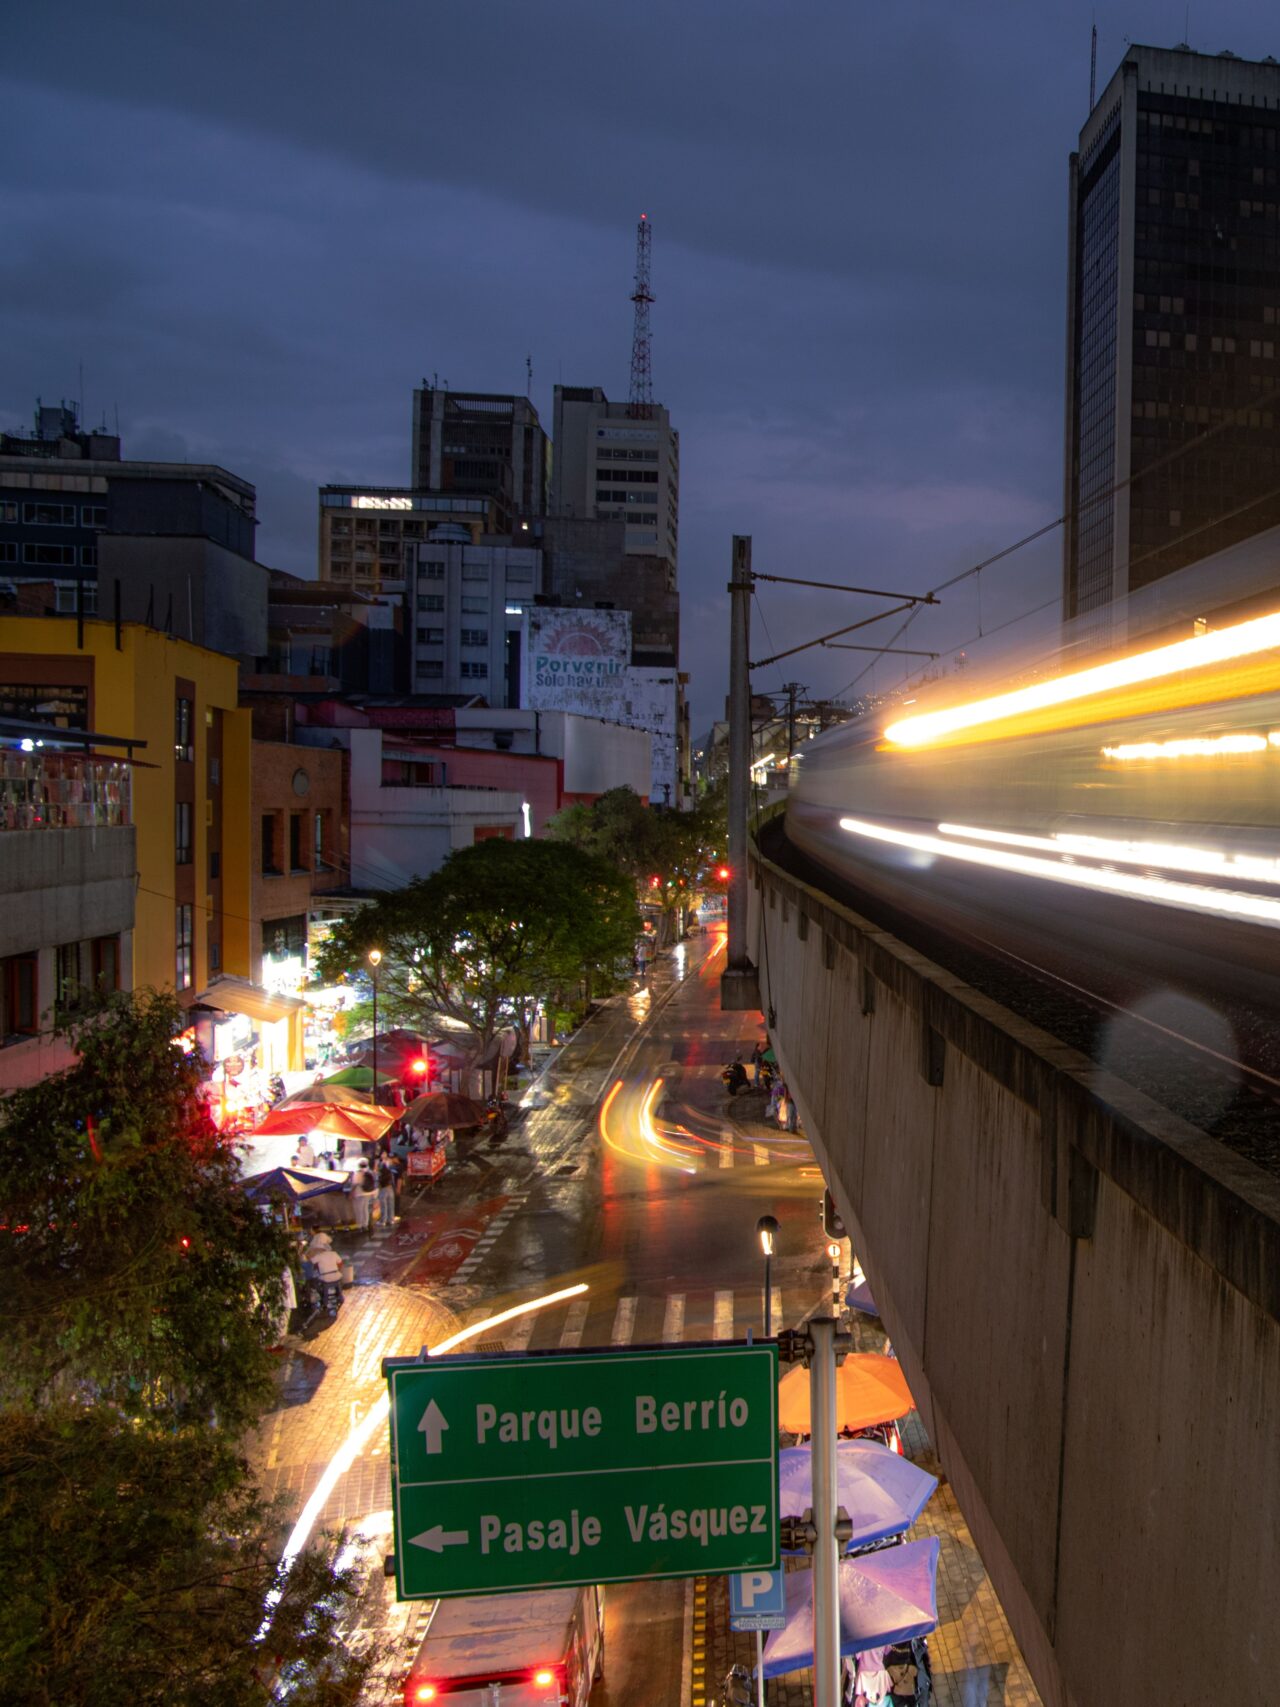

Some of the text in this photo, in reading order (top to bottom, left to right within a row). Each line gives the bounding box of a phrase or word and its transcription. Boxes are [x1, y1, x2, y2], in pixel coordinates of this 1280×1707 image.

[536, 656, 622, 674] Porvenir
[567, 674, 593, 688] hay
[477, 1391, 749, 1449] Parque Berrío
[480, 1503, 767, 1555] Pasaje Vásquez
[741, 1571, 773, 1607] P
